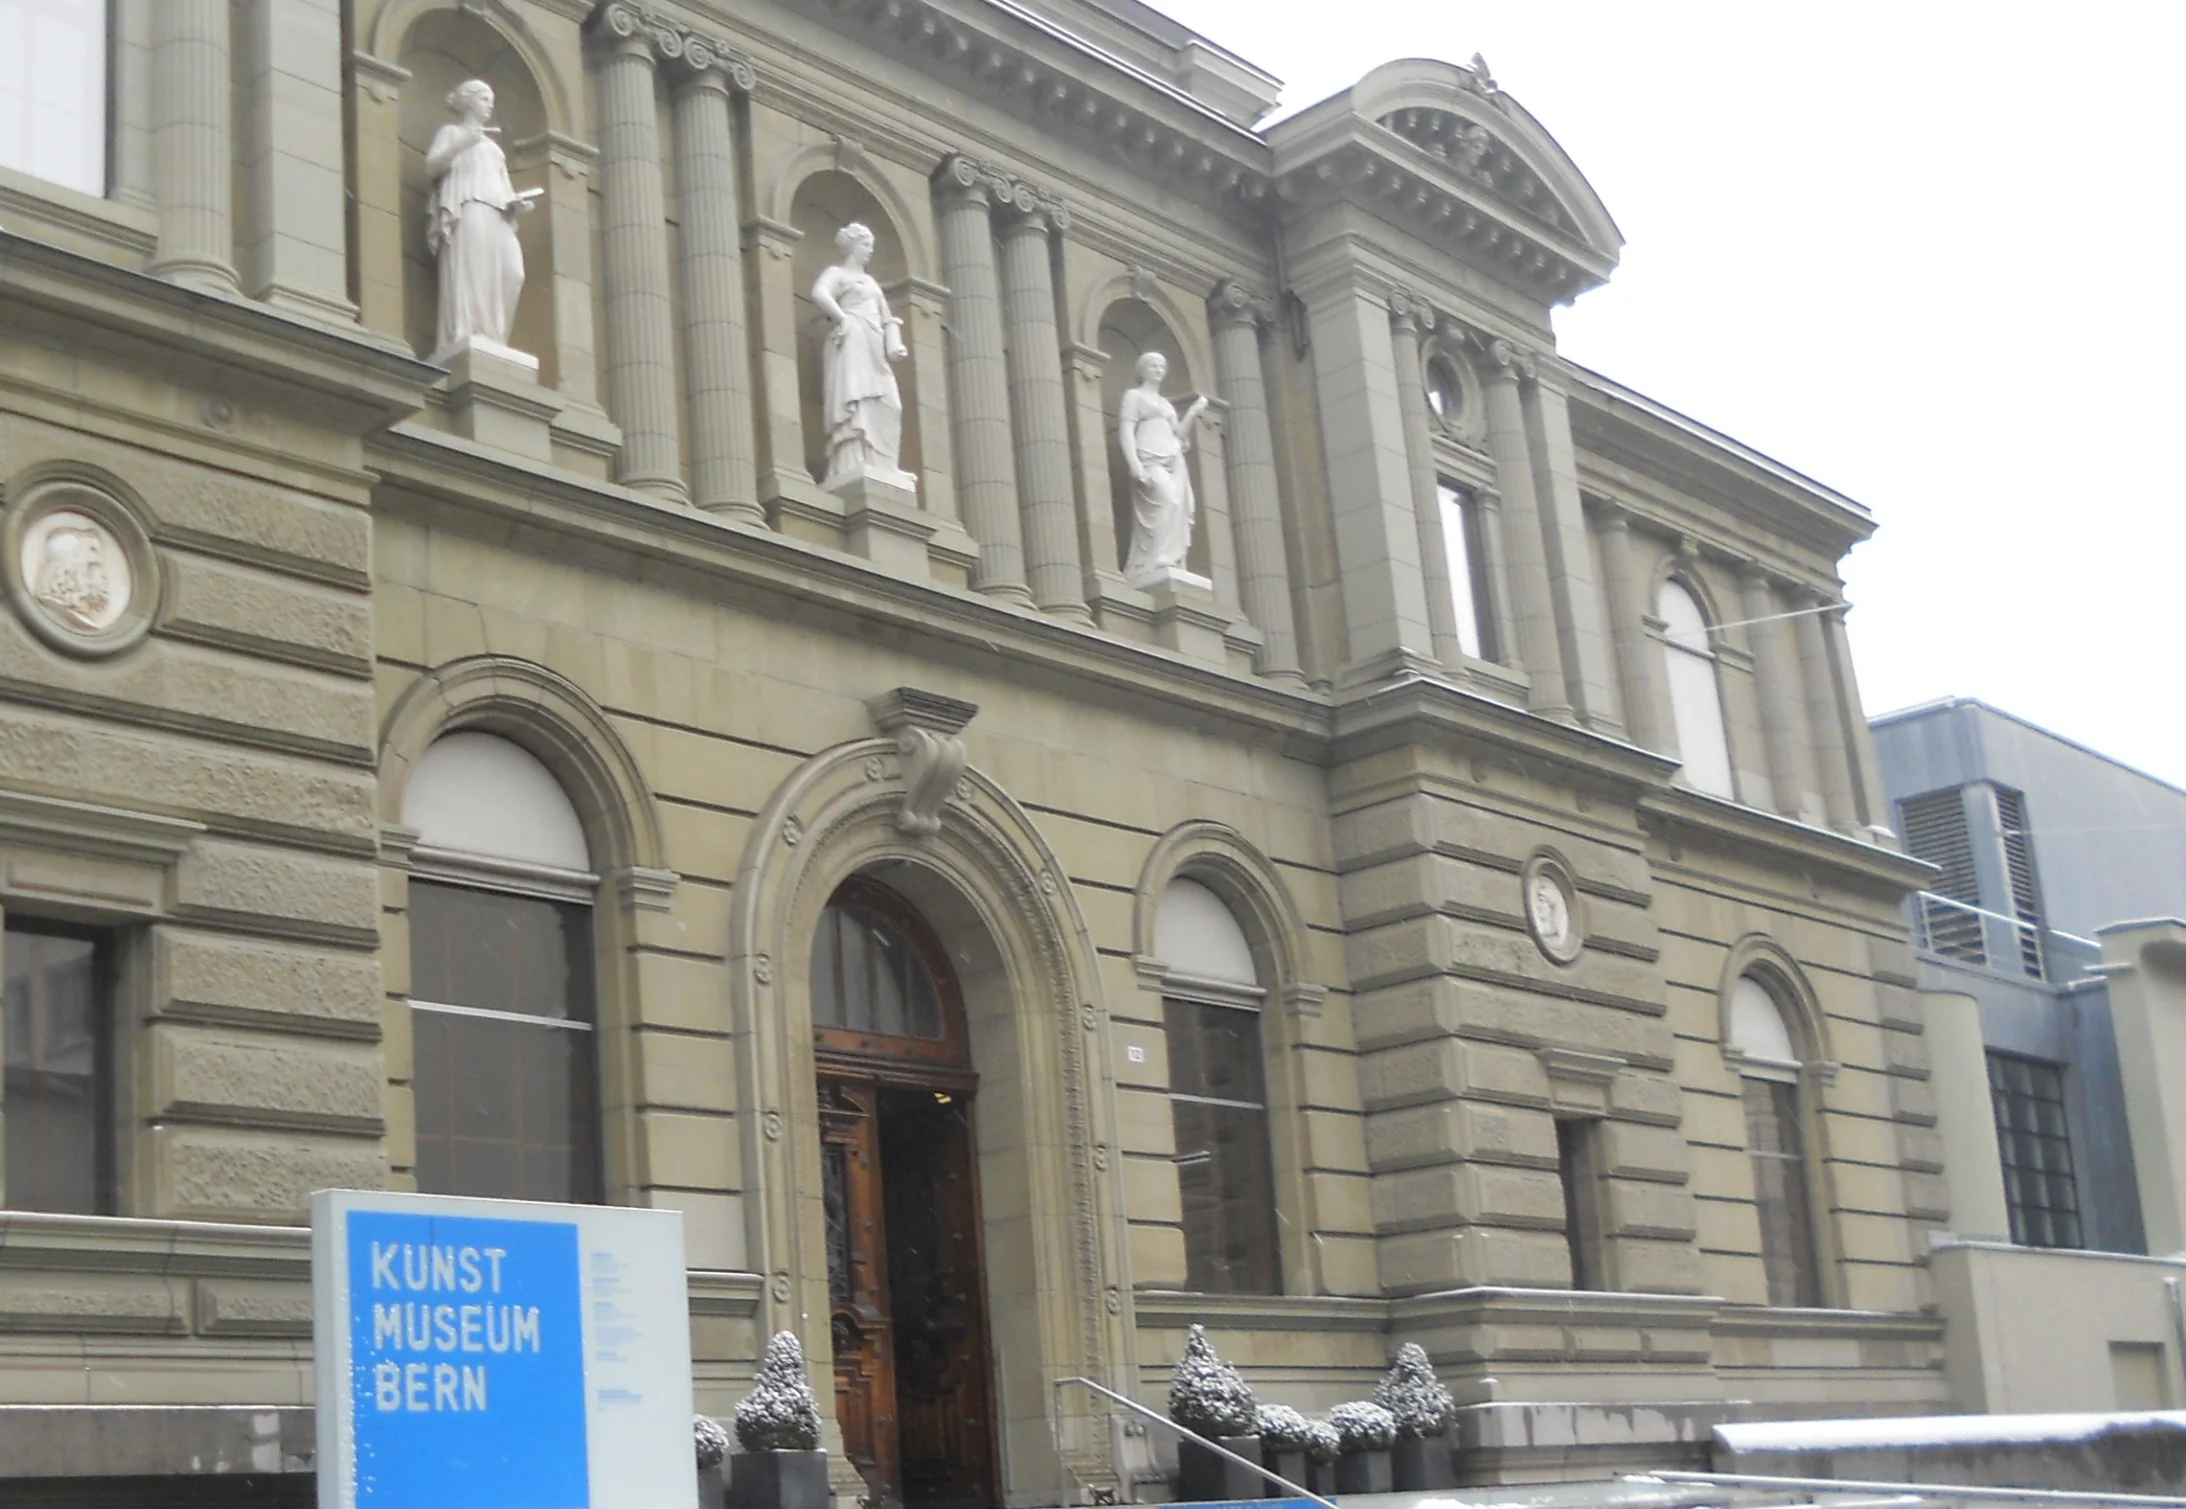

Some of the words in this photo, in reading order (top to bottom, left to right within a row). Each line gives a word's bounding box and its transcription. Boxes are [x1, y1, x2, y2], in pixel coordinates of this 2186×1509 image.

[371, 1241, 506, 1293] KUNST
[374, 1302, 540, 1353] MUSEUM
[375, 1361, 488, 1412] BERN
